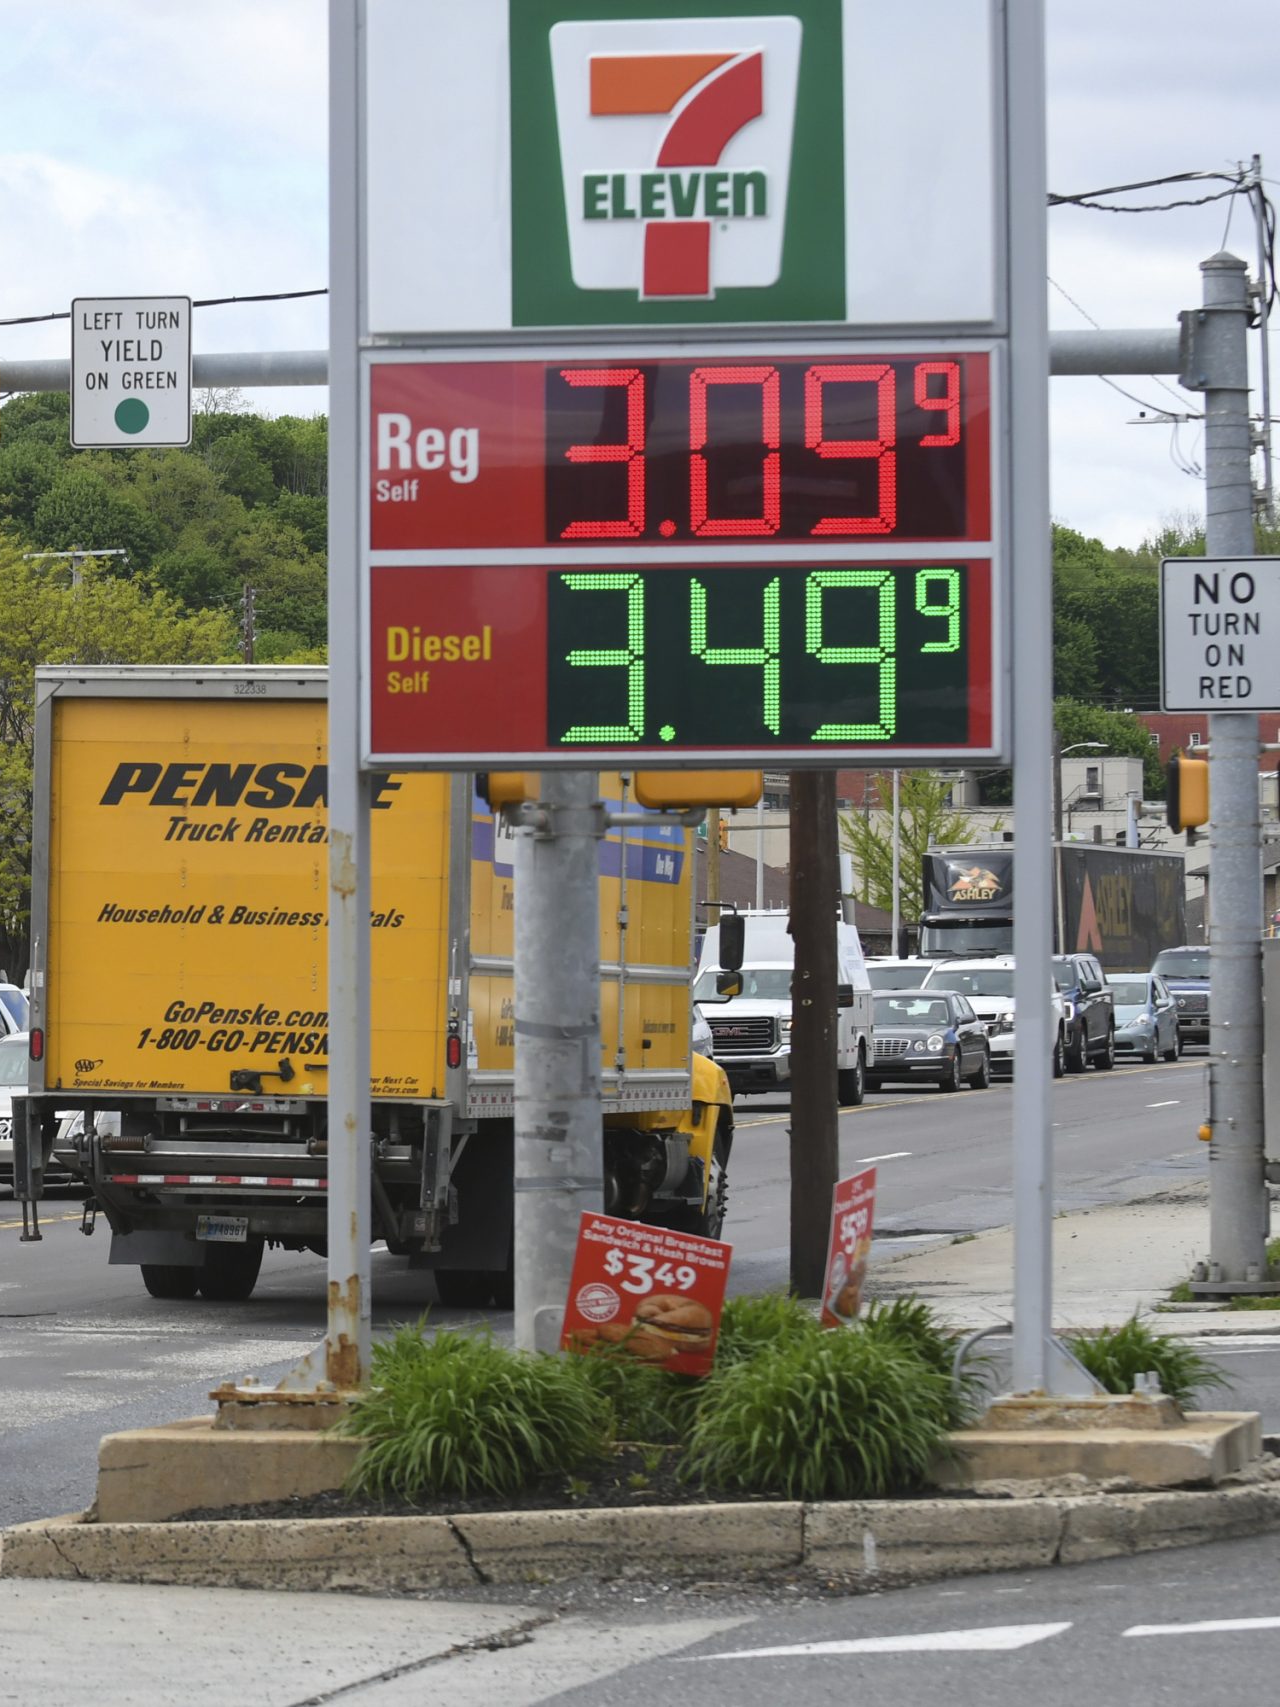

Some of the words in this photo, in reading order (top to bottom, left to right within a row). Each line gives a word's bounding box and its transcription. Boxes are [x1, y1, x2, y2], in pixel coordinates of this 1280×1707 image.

[589, 51, 763, 296] 7
[83, 312, 123, 331] LEFT
[136, 311, 180, 330] TURN
[100, 339, 163, 362] YIELD
[85, 372, 108, 390] ON
[122, 371, 177, 390] GREEN
[375, 412, 481, 484] Reg
[375, 479, 420, 503] Self
[1193, 571, 1256, 605] NO
[1187, 611, 1261, 636] TURN
[386, 626, 492, 662] Diesel
[1204, 643, 1245, 668] ON
[233, 684, 267, 695] 322338
[386, 671, 430, 695] Self
[1199, 675, 1252, 699] RED
[164, 816, 242, 842] Truck
[244, 817, 329, 844] Renta
[952, 887, 996, 902] ASHLEY
[97, 903, 207, 924] Household
[207, 905, 225, 925] &
[228, 905, 325, 927] Business
[712, 1026, 749, 1037] GMC
[73, 1078, 102, 1088] Special
[104, 1079, 134, 1089] Savings
[135, 1080, 147, 1088] for
[148, 1080, 185, 1089] Members
[582, 1228, 641, 1251] Sandwich
[641, 1242, 652, 1253] &
[653, 1244, 684, 1260] Hash
[685, 1252, 725, 1270] Brown
[590, 1219, 616, 1234] Any
[616, 1224, 664, 1243] Original
[664, 1236, 723, 1258] Breakfast
